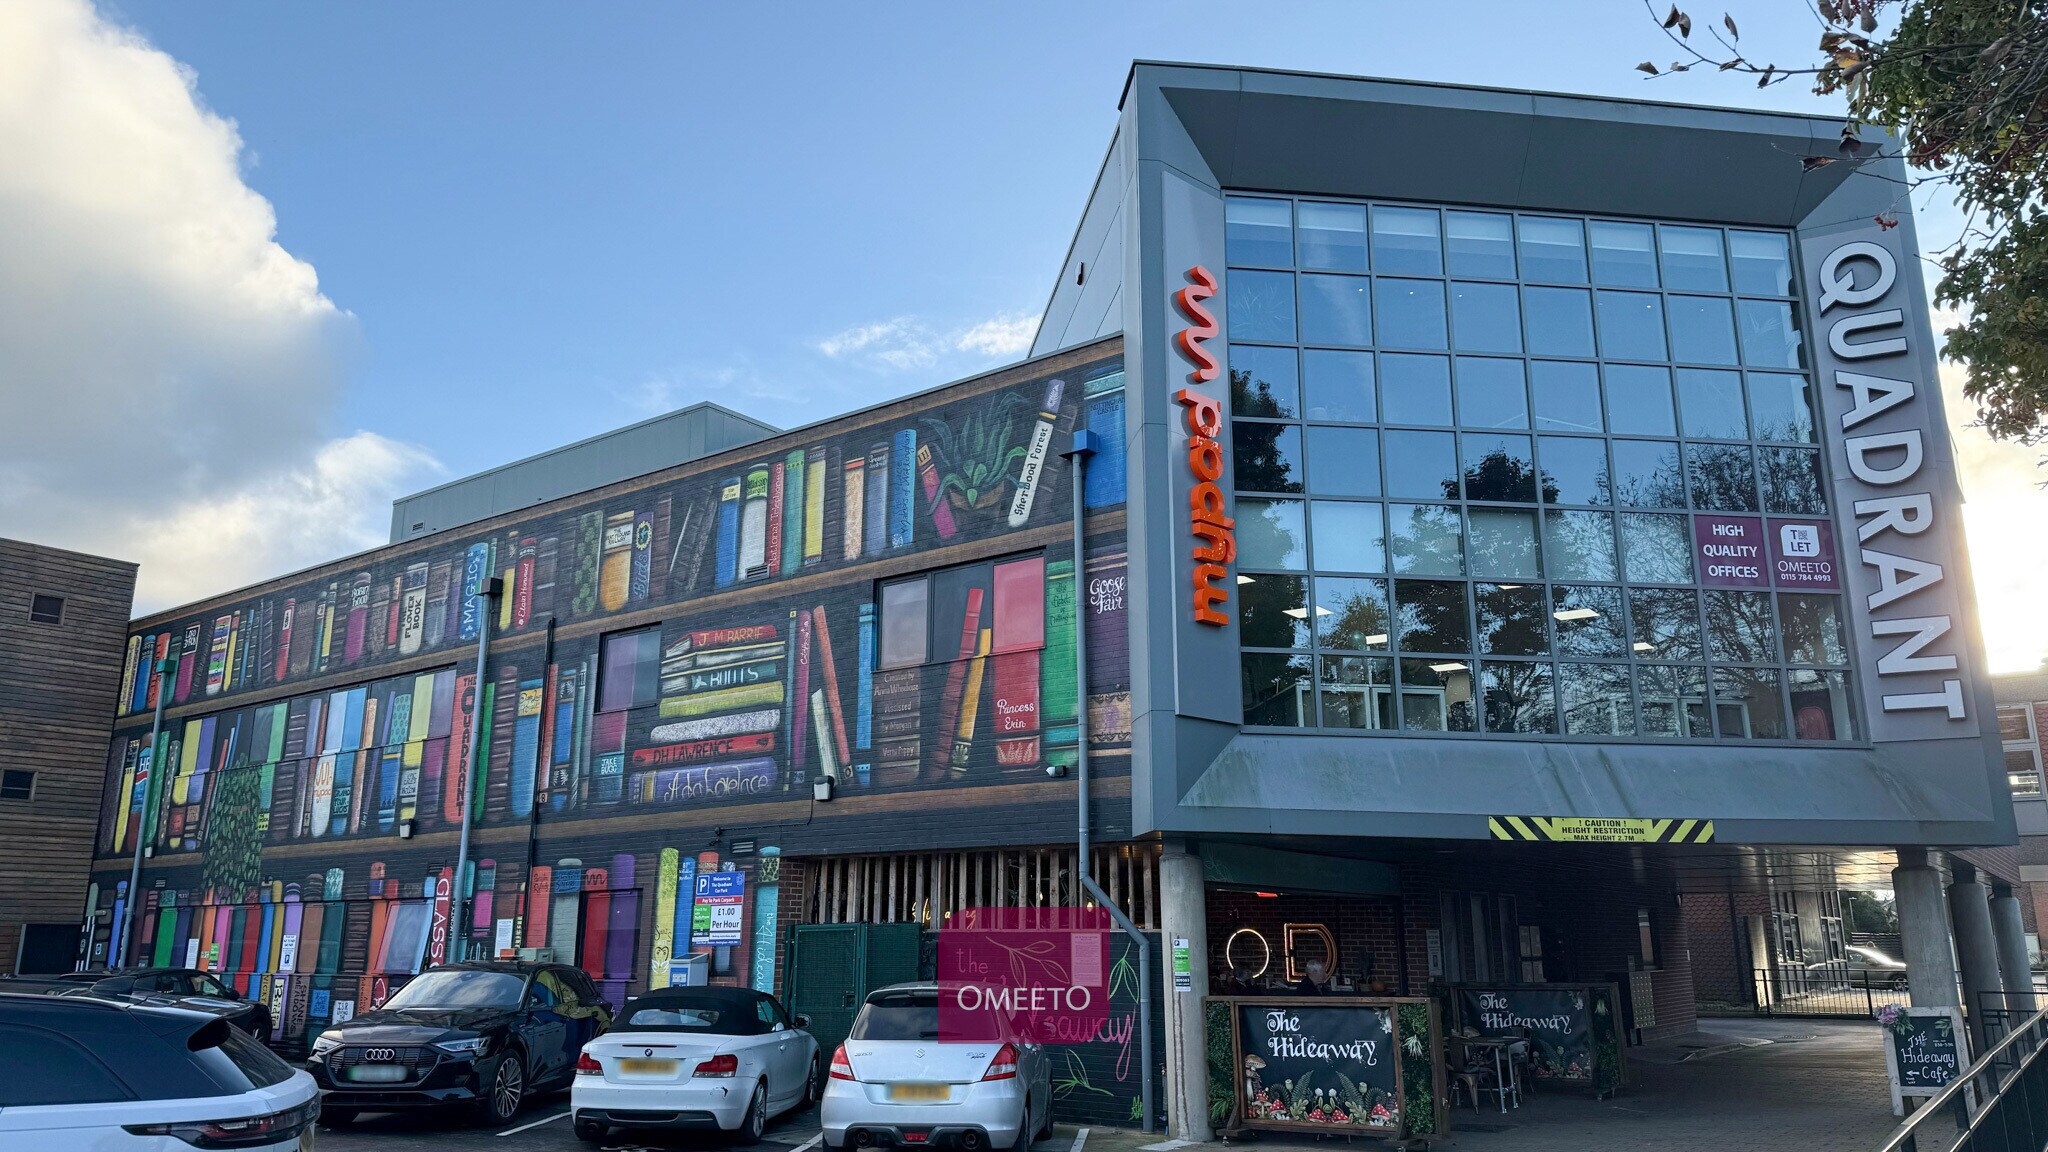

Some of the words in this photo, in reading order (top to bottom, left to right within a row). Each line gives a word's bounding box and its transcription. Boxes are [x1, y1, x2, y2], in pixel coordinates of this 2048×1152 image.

[1819, 241, 1965, 720] QUADRANT
[1178, 388, 1237, 627] mypad
[1712, 524, 1744, 537] HIGH
[769, 522, 779, 567] National
[1703, 544, 1758, 558] QUALITY
[1790, 542, 1811, 553] LET
[633, 554, 648, 599] Birds
[1708, 565, 1759, 578] OFFICES
[1778, 560, 1831, 574] OMEETO
[1781, 573, 1796, 581] 0115
[463, 563, 478, 624] MAGIC
[1090, 576, 1126, 605] Goose
[1096, 594, 1124, 614] Fair
[413, 598, 422, 630] BOOK
[714, 631, 724, 642] M
[885, 701, 912, 713] Assisted
[997, 698, 1034, 715] Princess
[653, 749, 669, 764] DH
[672, 739, 733, 761] LAWRENCE
[1584, 819, 1621, 827] CAUTION
[1593, 827, 1645, 835] RESTRICTION
[700, 878, 707, 893] P
[431, 878, 450, 958] GLASS
[718, 908, 735, 916] £1.00
[712, 921, 722, 929] Per
[724, 921, 740, 929] Hour
[955, 948, 989, 974] the
[296, 985, 307, 1026] SHANE
[1479, 991, 1508, 1010] The
[1266, 1011, 1300, 1032] The
[1481, 1012, 1572, 1034] Hideaway
[1908, 1031, 1928, 1048] THE
[1267, 1036, 1377, 1066] Hideaway
[1900, 1047, 1955, 1068] Hideaway
[1922, 1066, 1949, 1083] Cafe
